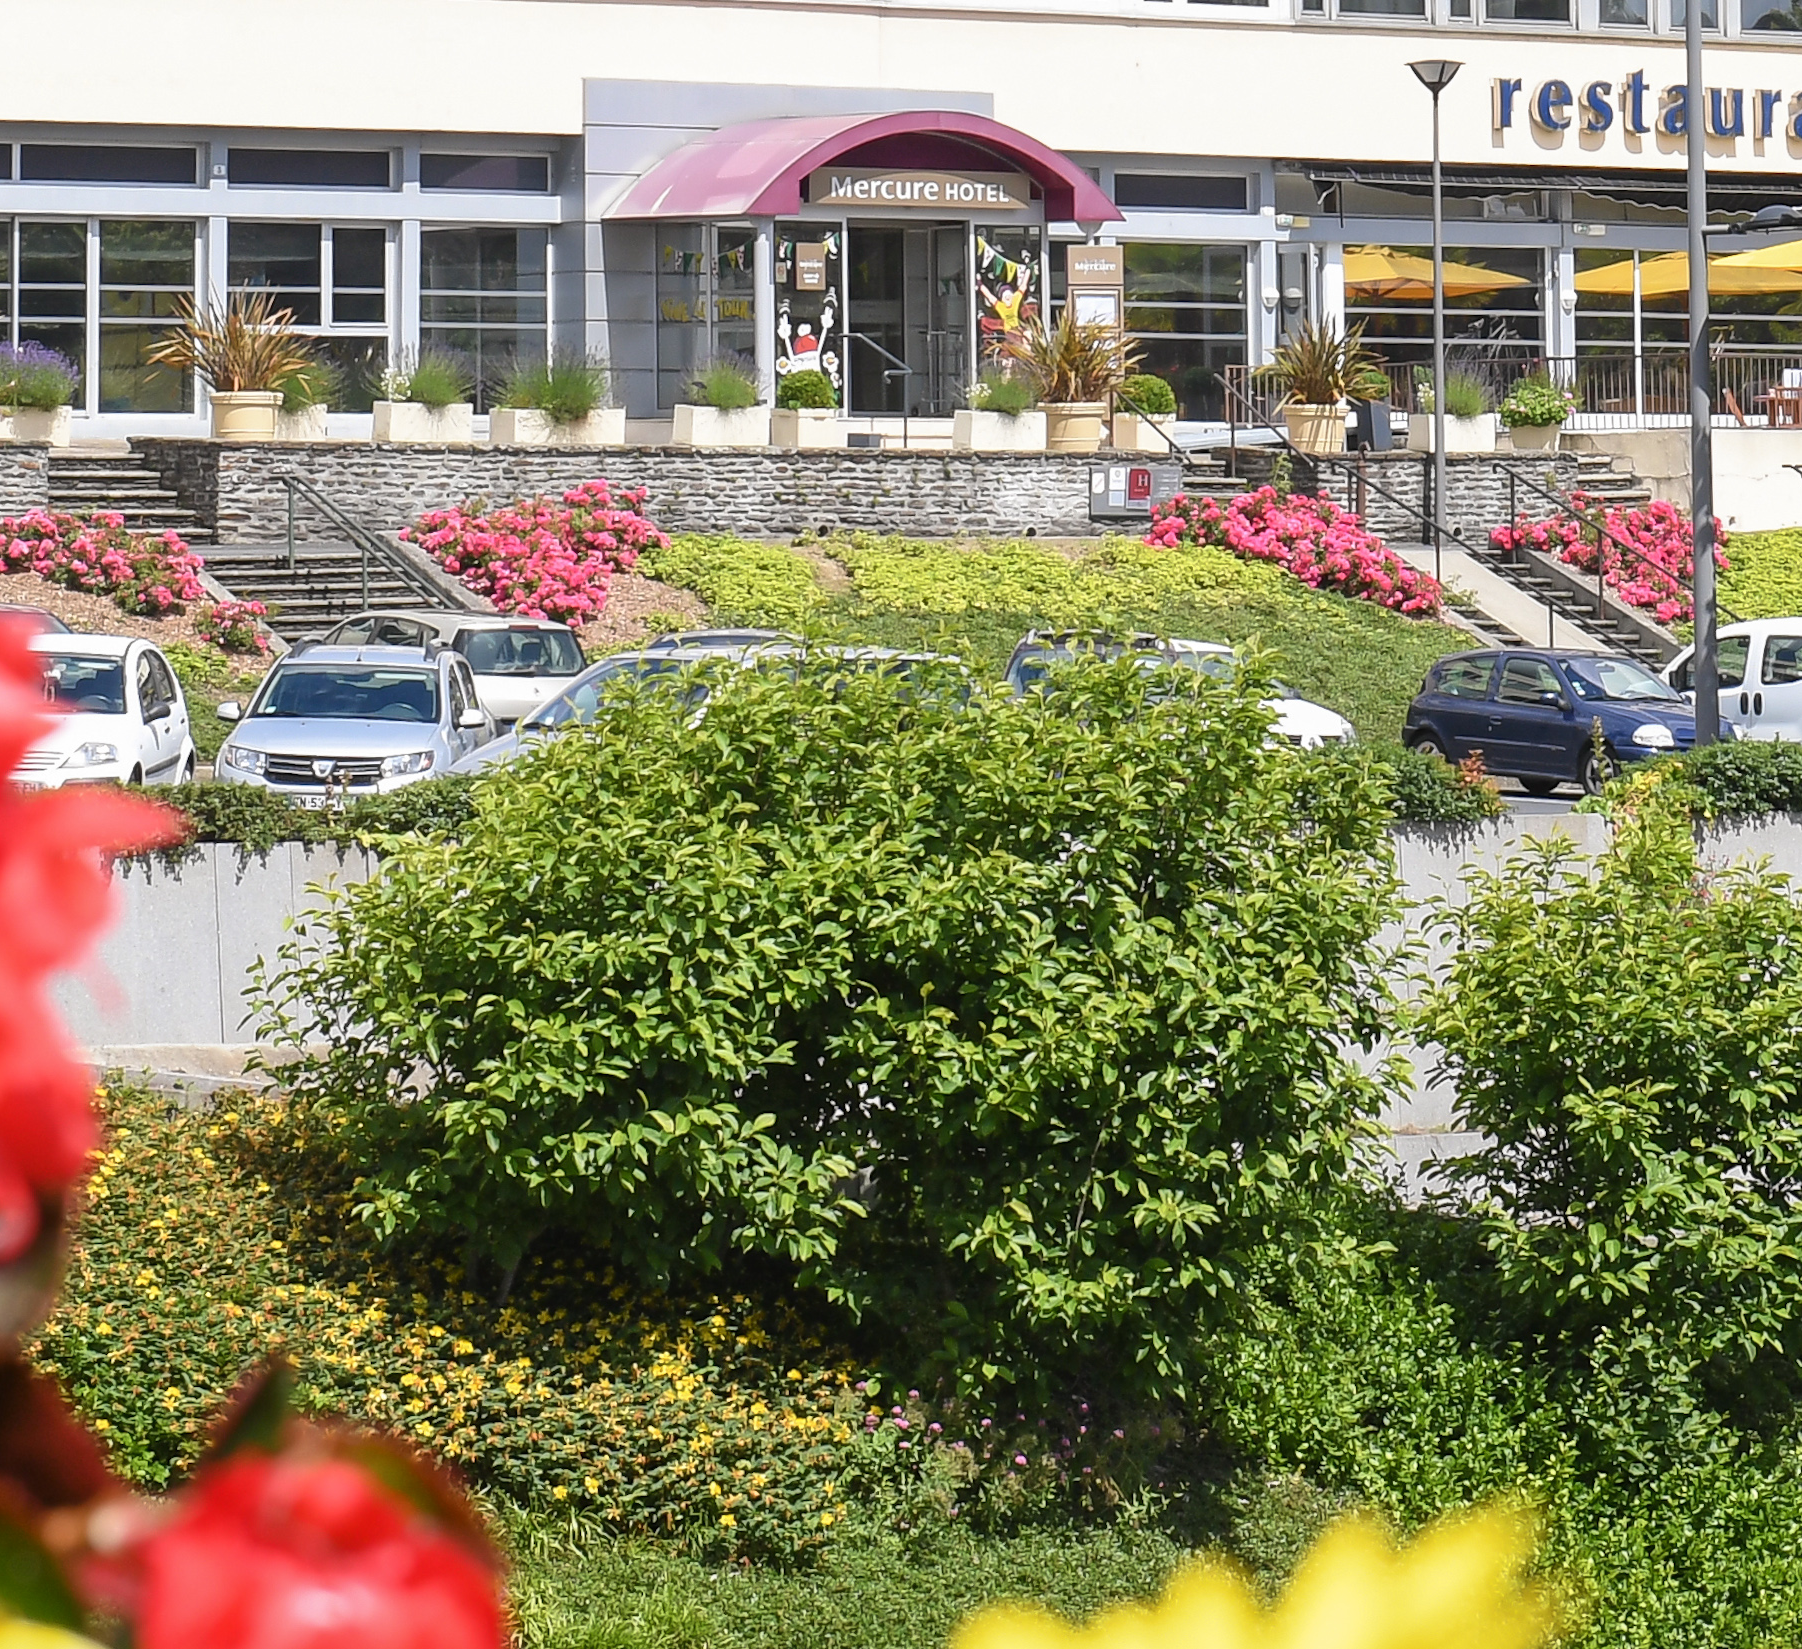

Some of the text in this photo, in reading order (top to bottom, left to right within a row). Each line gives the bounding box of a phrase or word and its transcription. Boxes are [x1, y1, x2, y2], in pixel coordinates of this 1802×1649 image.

[830, 175, 1010, 203] Mercure HOTEL
[1137, 474, 1149, 487] H
